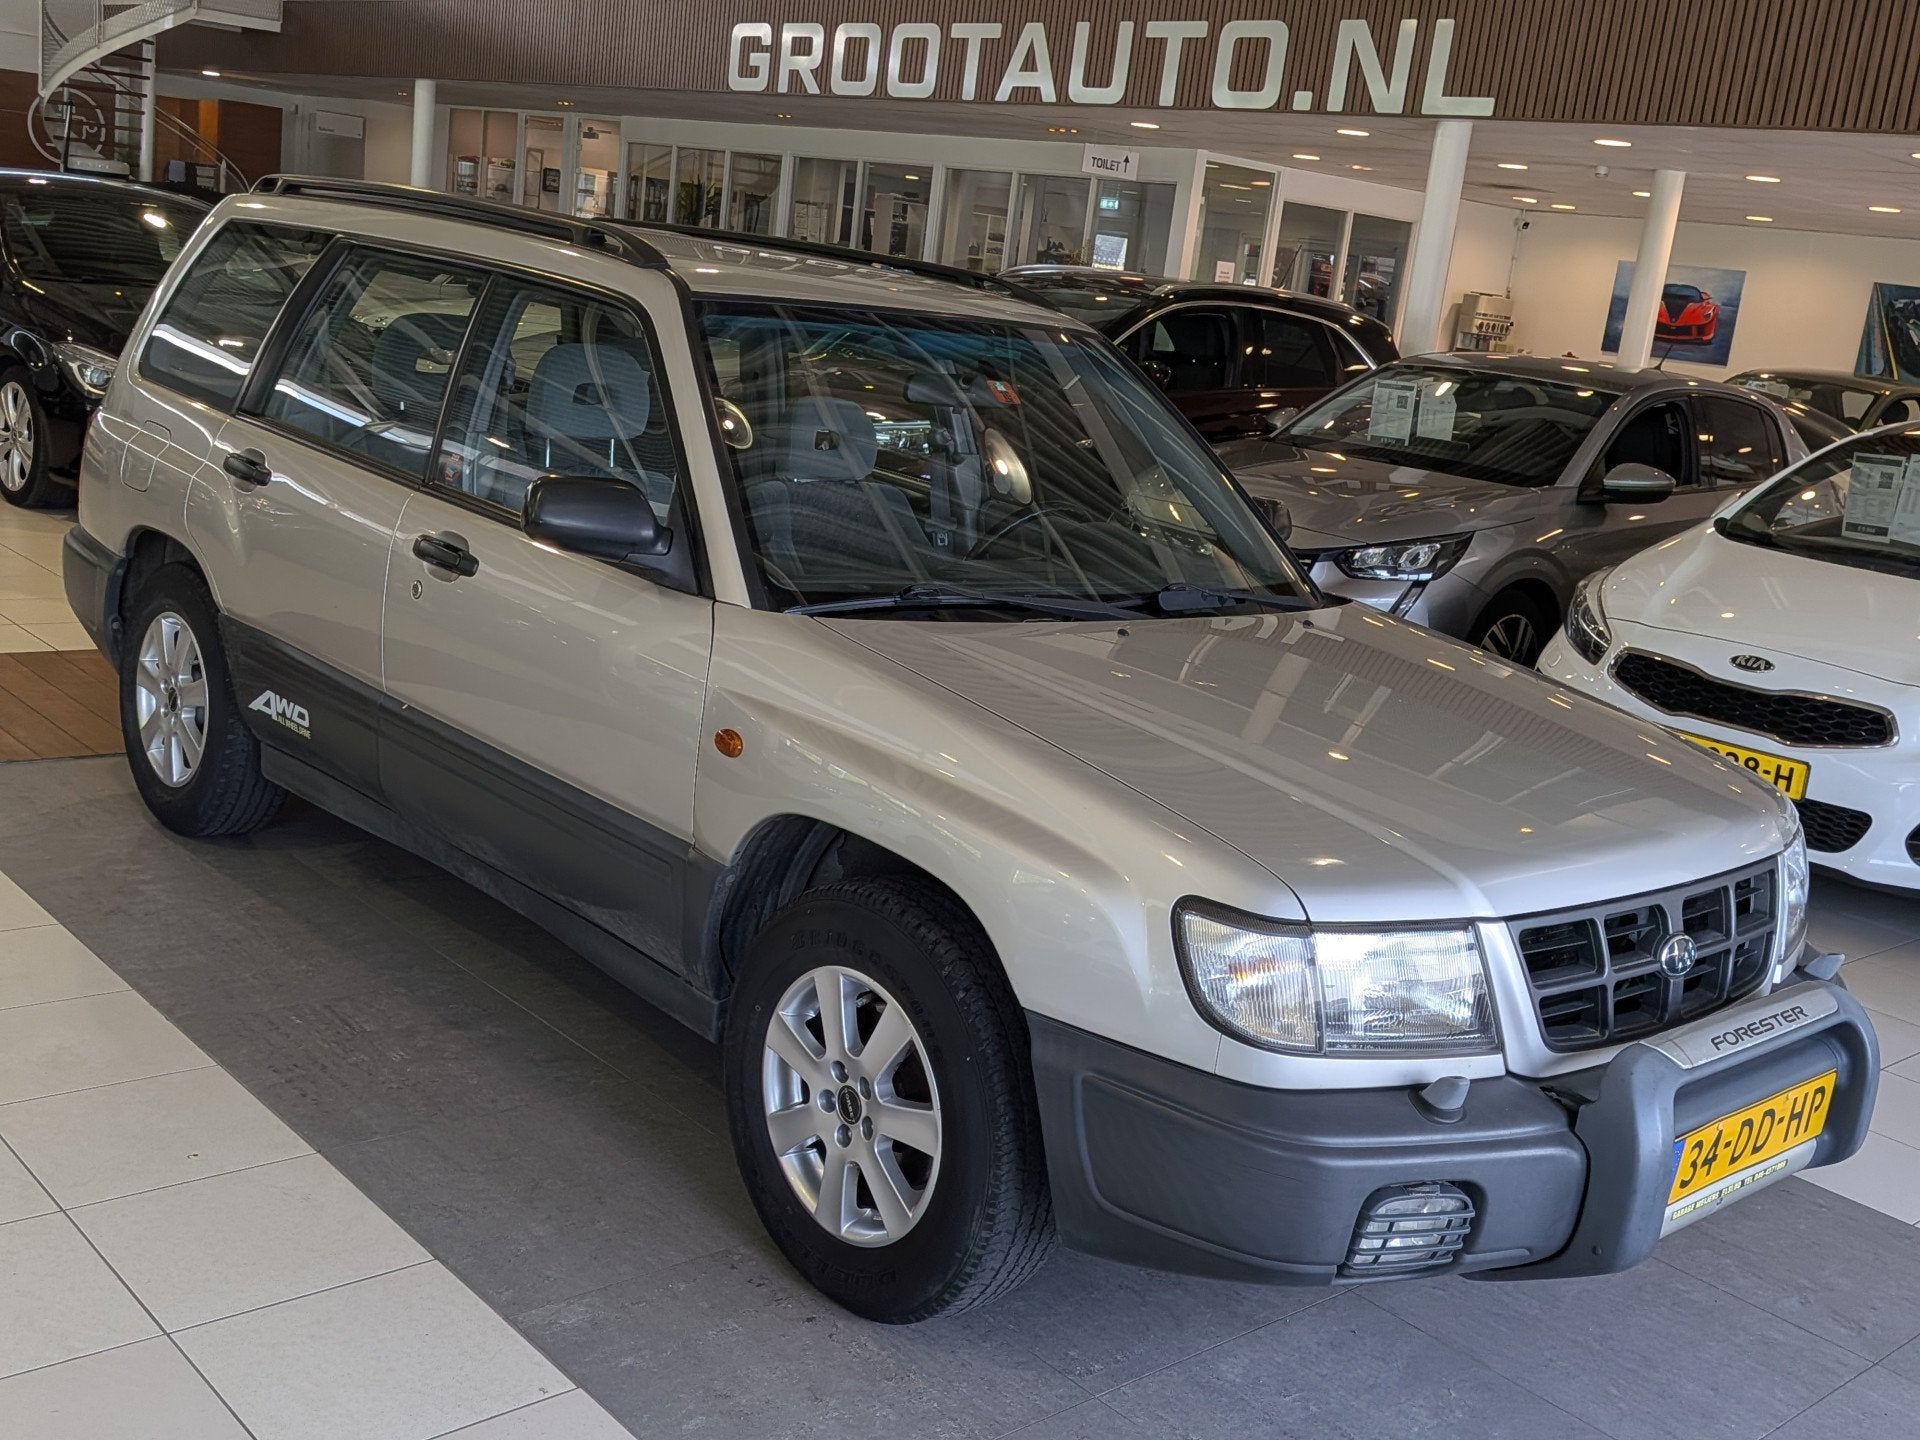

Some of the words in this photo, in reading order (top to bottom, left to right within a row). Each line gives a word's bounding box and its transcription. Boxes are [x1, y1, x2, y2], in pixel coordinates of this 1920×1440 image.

[728, 18, 1495, 117] GROOTAUTO.NL
[1091, 156, 1122, 172] TOILET
[1735, 655, 1768, 670] KIA
[248, 690, 310, 728] AWD
[1710, 1005, 1809, 1051] FORESTER
[1679, 1085, 1826, 1189] 34-DD-HP
[1672, 1203, 1695, 1220] GARAGE
